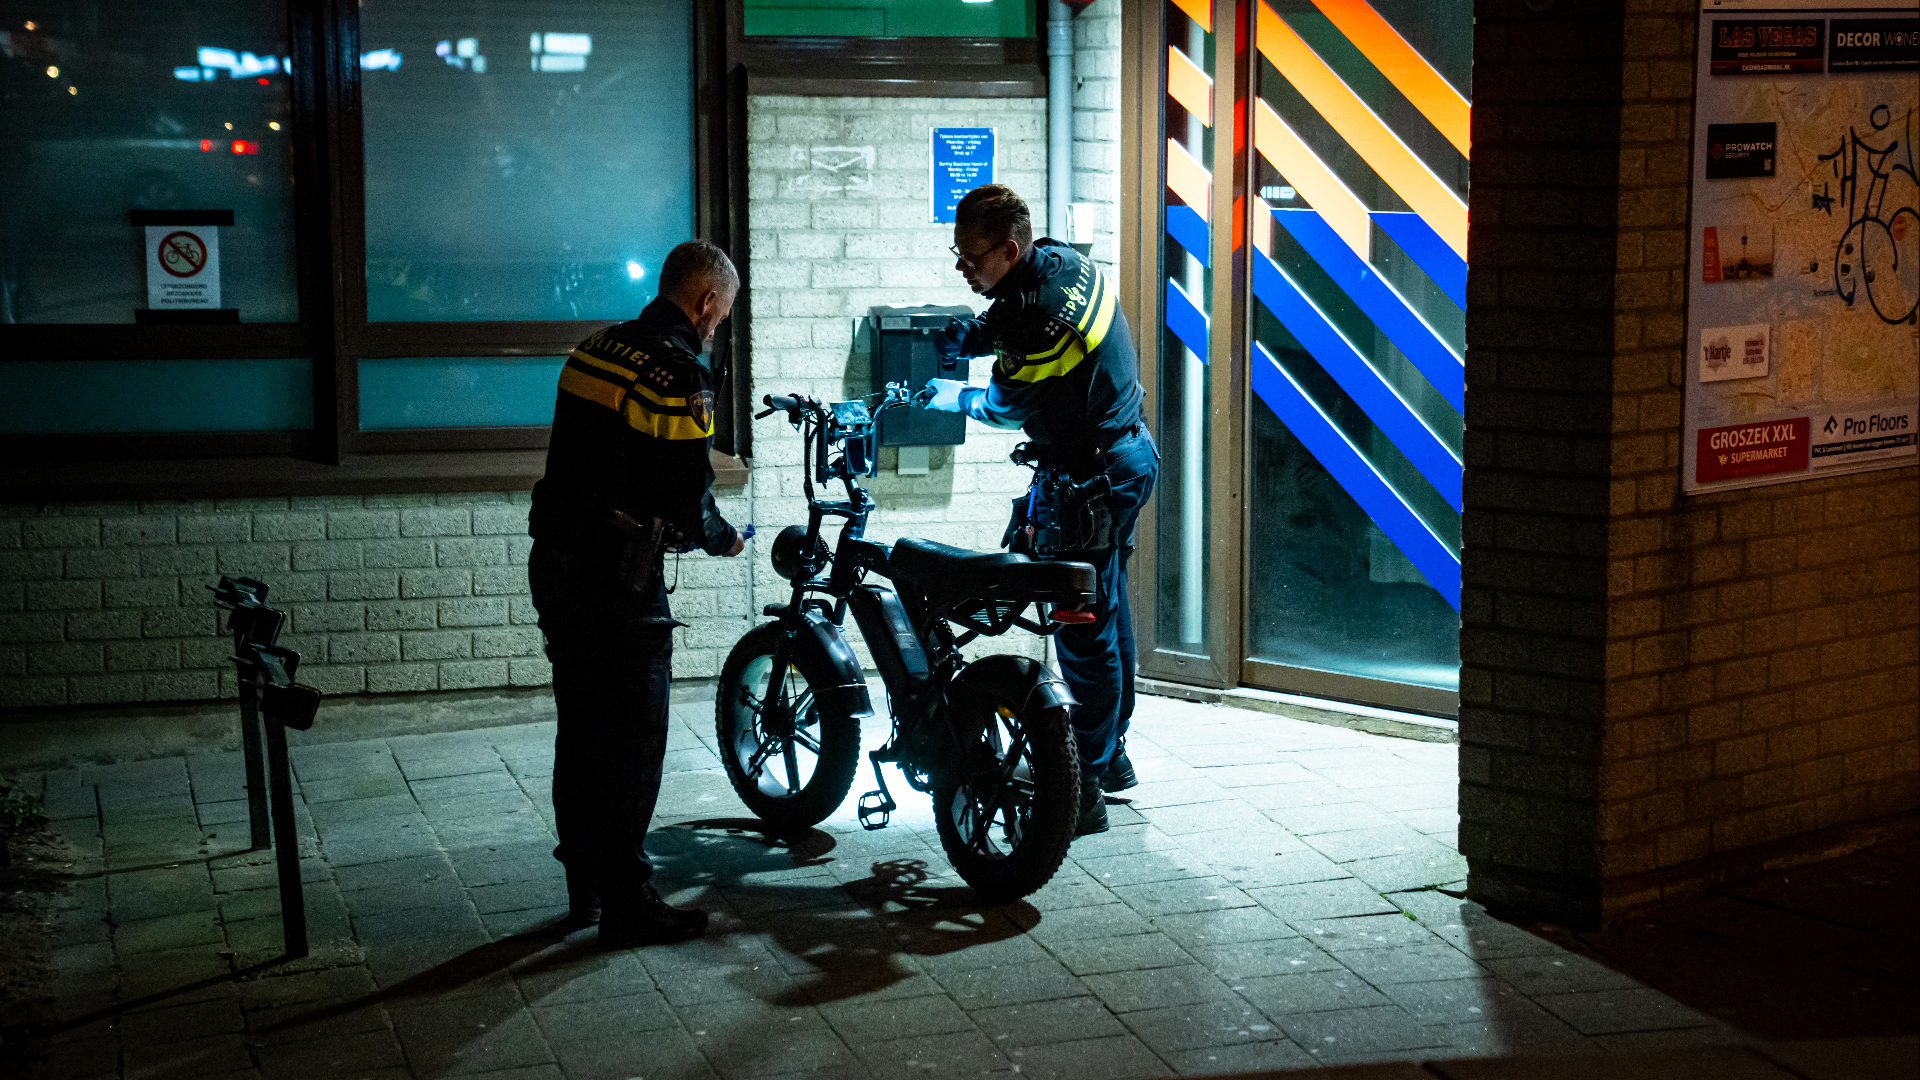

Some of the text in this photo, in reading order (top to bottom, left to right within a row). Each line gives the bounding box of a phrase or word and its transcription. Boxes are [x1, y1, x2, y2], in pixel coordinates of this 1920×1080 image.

[1719, 26, 1817, 48] LAS VEGAS
[1837, 32, 1919, 47] DECOR WONE
[1725, 142, 1772, 152] PROWATCH
[1064, 255, 1090, 311] POLITIE
[583, 332, 644, 362] OLITIE
[1709, 344, 1731, 362] Hartje
[1844, 414, 1909, 437] Pro Floors
[1711, 424, 1796, 450] GROSZEK XXL
[1731, 446, 1788, 464] SUPERMARKET
